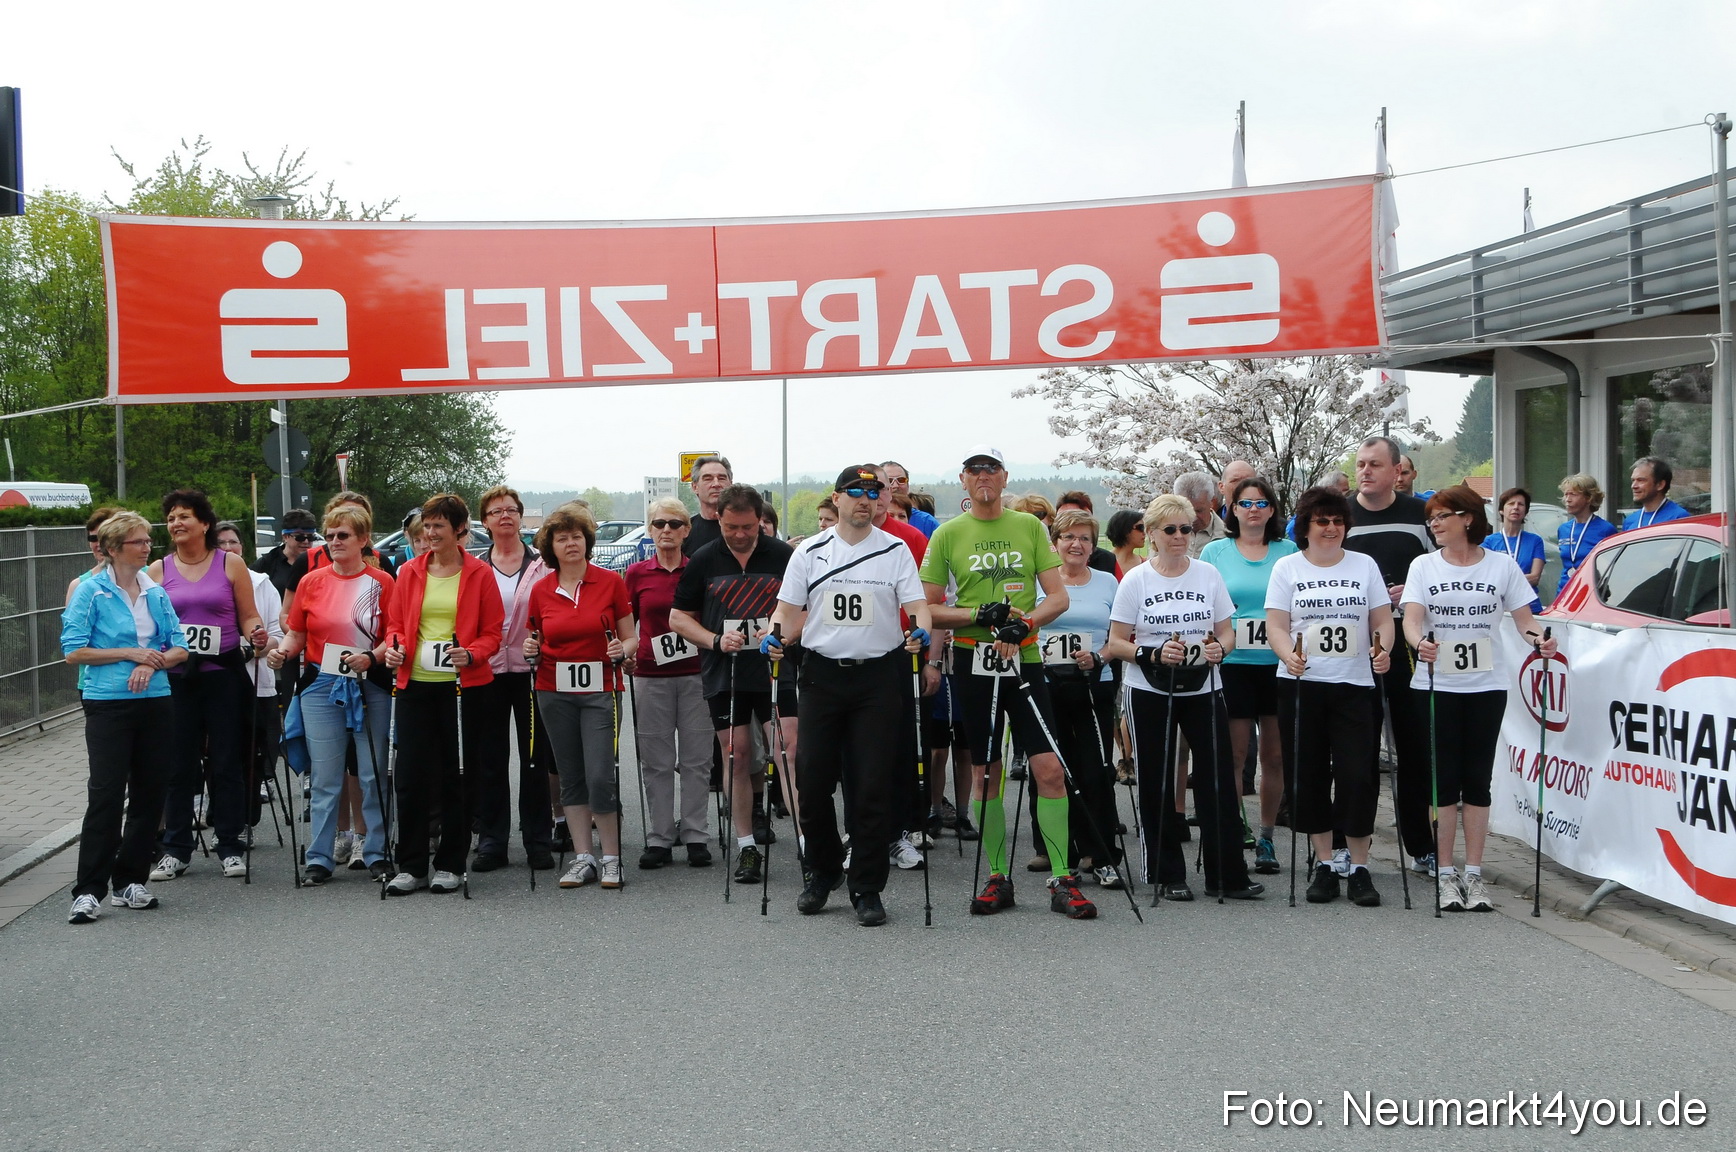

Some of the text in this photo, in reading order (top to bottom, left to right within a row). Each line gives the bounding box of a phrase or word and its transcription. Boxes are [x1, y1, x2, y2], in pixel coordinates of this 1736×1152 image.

[29, 493, 89, 502] www.buchbinder.de
[963, 501, 972, 510] 60
[974, 540, 1011, 552] FÜRTH
[968, 551, 1024, 572] 2012
[832, 578, 893, 587] www.fitness-neumarkt.de
[1297, 579, 1361, 592] BERGER
[1428, 581, 1497, 596] BERGER
[833, 593, 862, 621] 96
[1144, 590, 1206, 607] BERGER
[1295, 596, 1367, 608] POWER GIRLS
[1143, 609, 1212, 625] POWER GIRLS
[1340, 613, 1360, 621] talking
[1428, 602, 1498, 616] POWER GIRLS
[1186, 628, 1206, 636] talking
[1246, 620, 1268, 645] 14
[1472, 622, 1491, 630] talking
[186, 626, 212, 651] 26
[660, 635, 688, 658] 84
[1059, 634, 1082, 659] 16
[1319, 626, 1348, 653] 33
[432, 642, 454, 668] 12
[1453, 643, 1478, 670] 31
[567, 663, 591, 688] 10
[1527, 752, 1593, 800] MOTORS
[1603, 760, 1677, 793] AUTOHAUS
